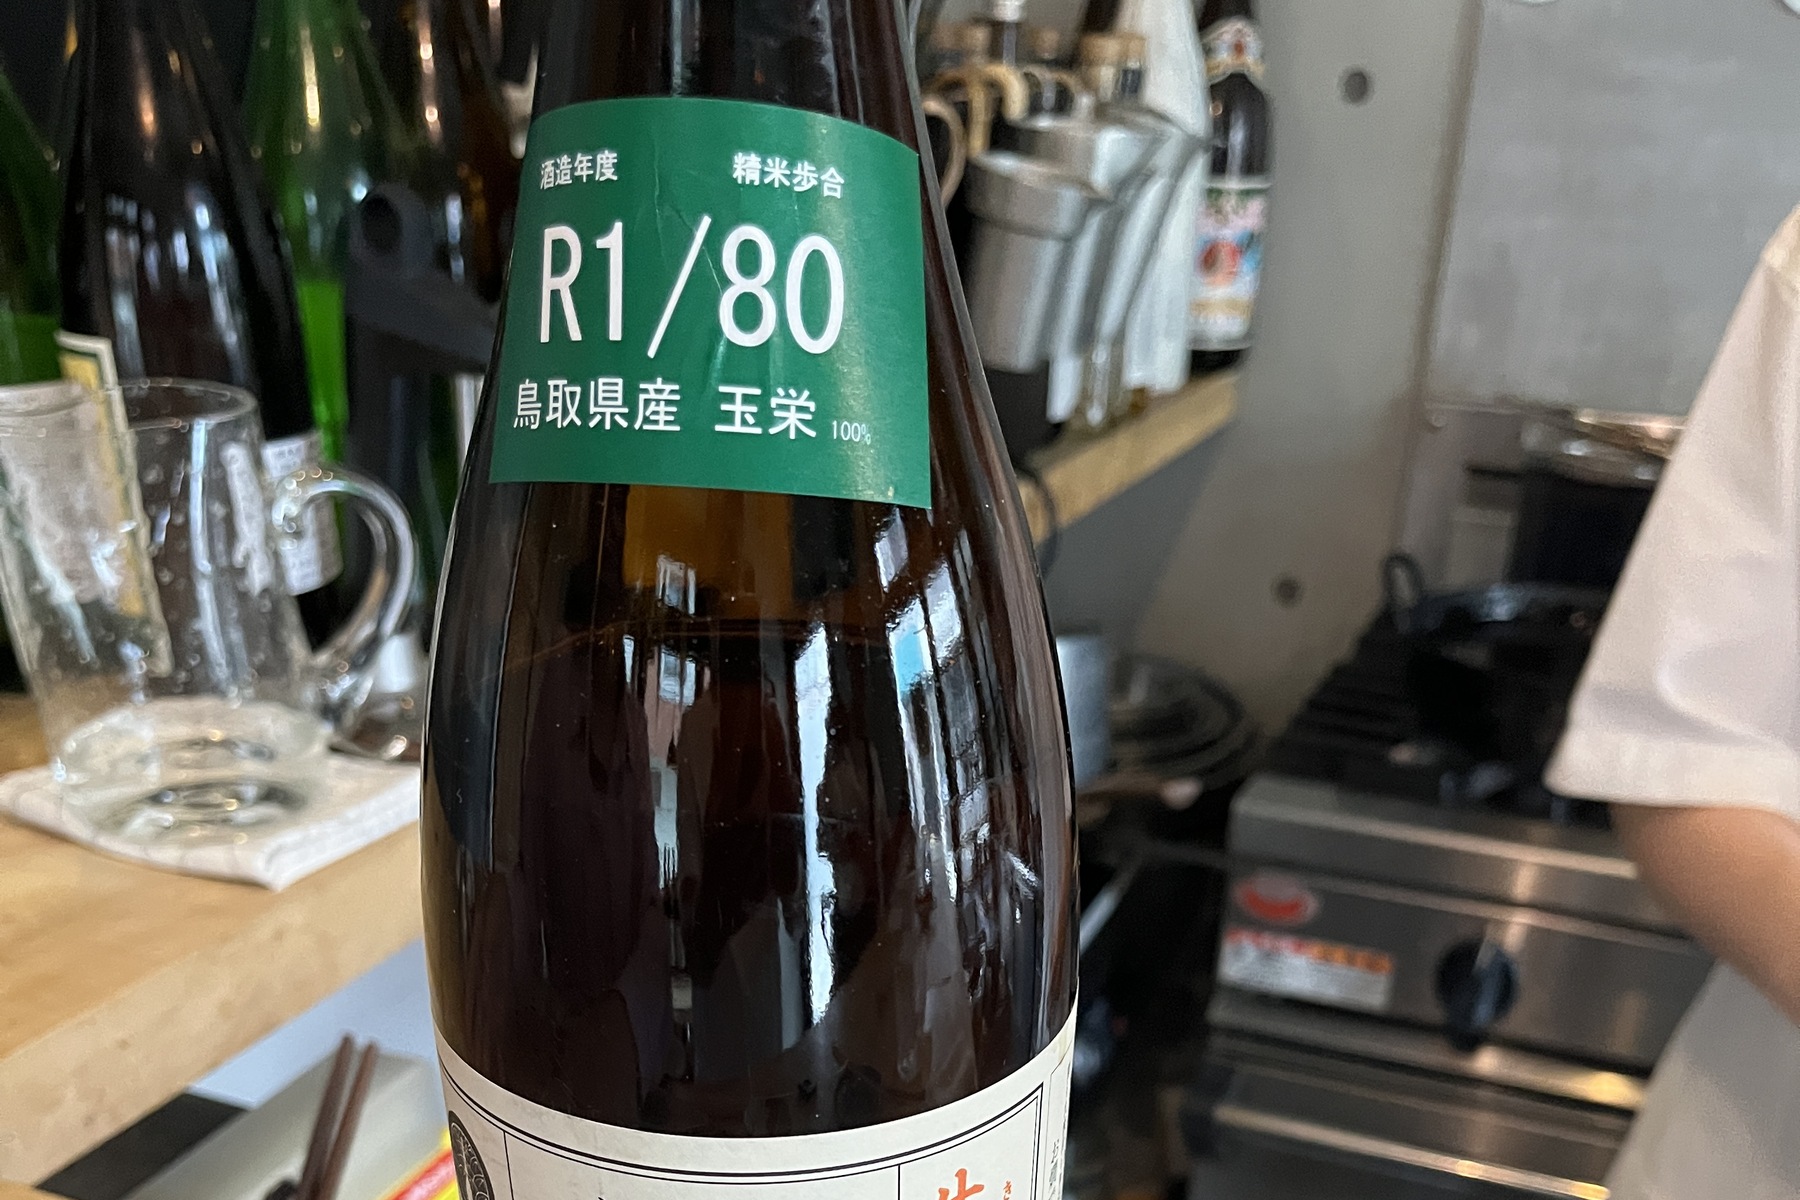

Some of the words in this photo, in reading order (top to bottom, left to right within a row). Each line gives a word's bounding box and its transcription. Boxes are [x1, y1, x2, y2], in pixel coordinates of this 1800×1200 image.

[539, 150, 619, 190] 酒造年度
[732, 151, 845, 199] 精米歩合
[512, 377, 682, 432] 鳥取県産
[714, 384, 817, 440] 玉栄
[830, 419, 872, 446] 100%
